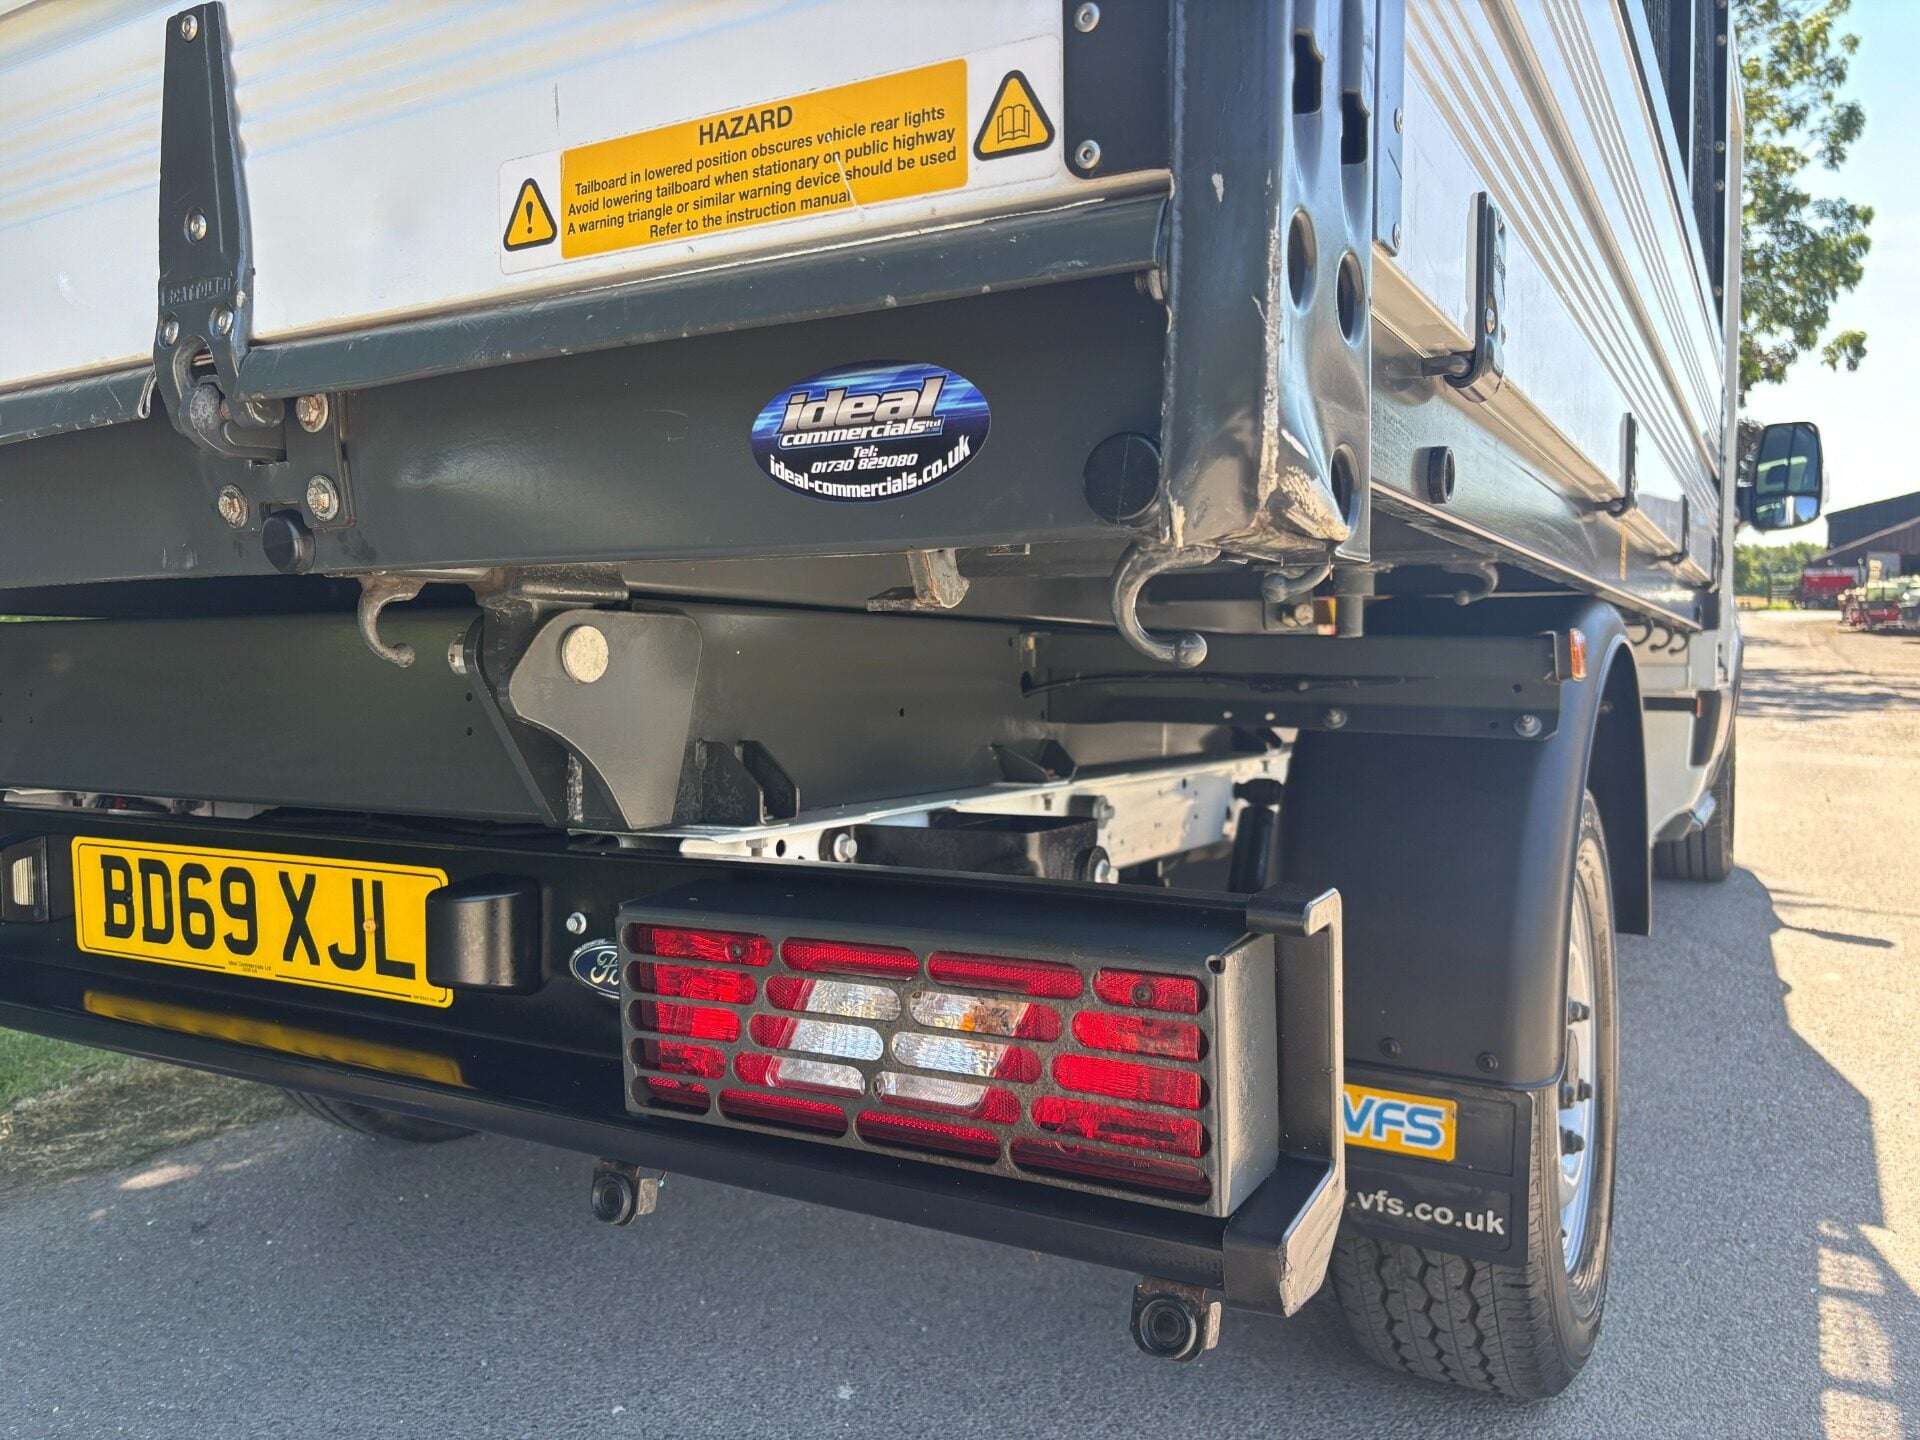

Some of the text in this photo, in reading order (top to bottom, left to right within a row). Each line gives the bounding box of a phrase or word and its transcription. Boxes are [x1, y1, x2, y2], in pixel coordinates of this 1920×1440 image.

[699, 105, 793, 146] HAZARD
[568, 127, 956, 216] Avoid lowering tailboard when stationary on public highway
[575, 107, 945, 196] Tailboard in lowered position obscures vehicle rear lights
[567, 146, 957, 235] A warning triangle or similar warning device should be used
[650, 190, 851, 238] Refer to the instruction manual
[779, 374, 947, 433] ideal
[781, 419, 926, 448] commercials
[852, 445, 879, 459] Tel:
[769, 433, 971, 498] ideal-commercials.co.uk
[810, 453, 919, 474] 01730 829080
[100, 853, 417, 982] BD69 XJL
[590, 950, 619, 986] Fo
[1343, 1095, 1445, 1149] VFS
[1350, 1189, 1506, 1236] .vfs.co.uk
